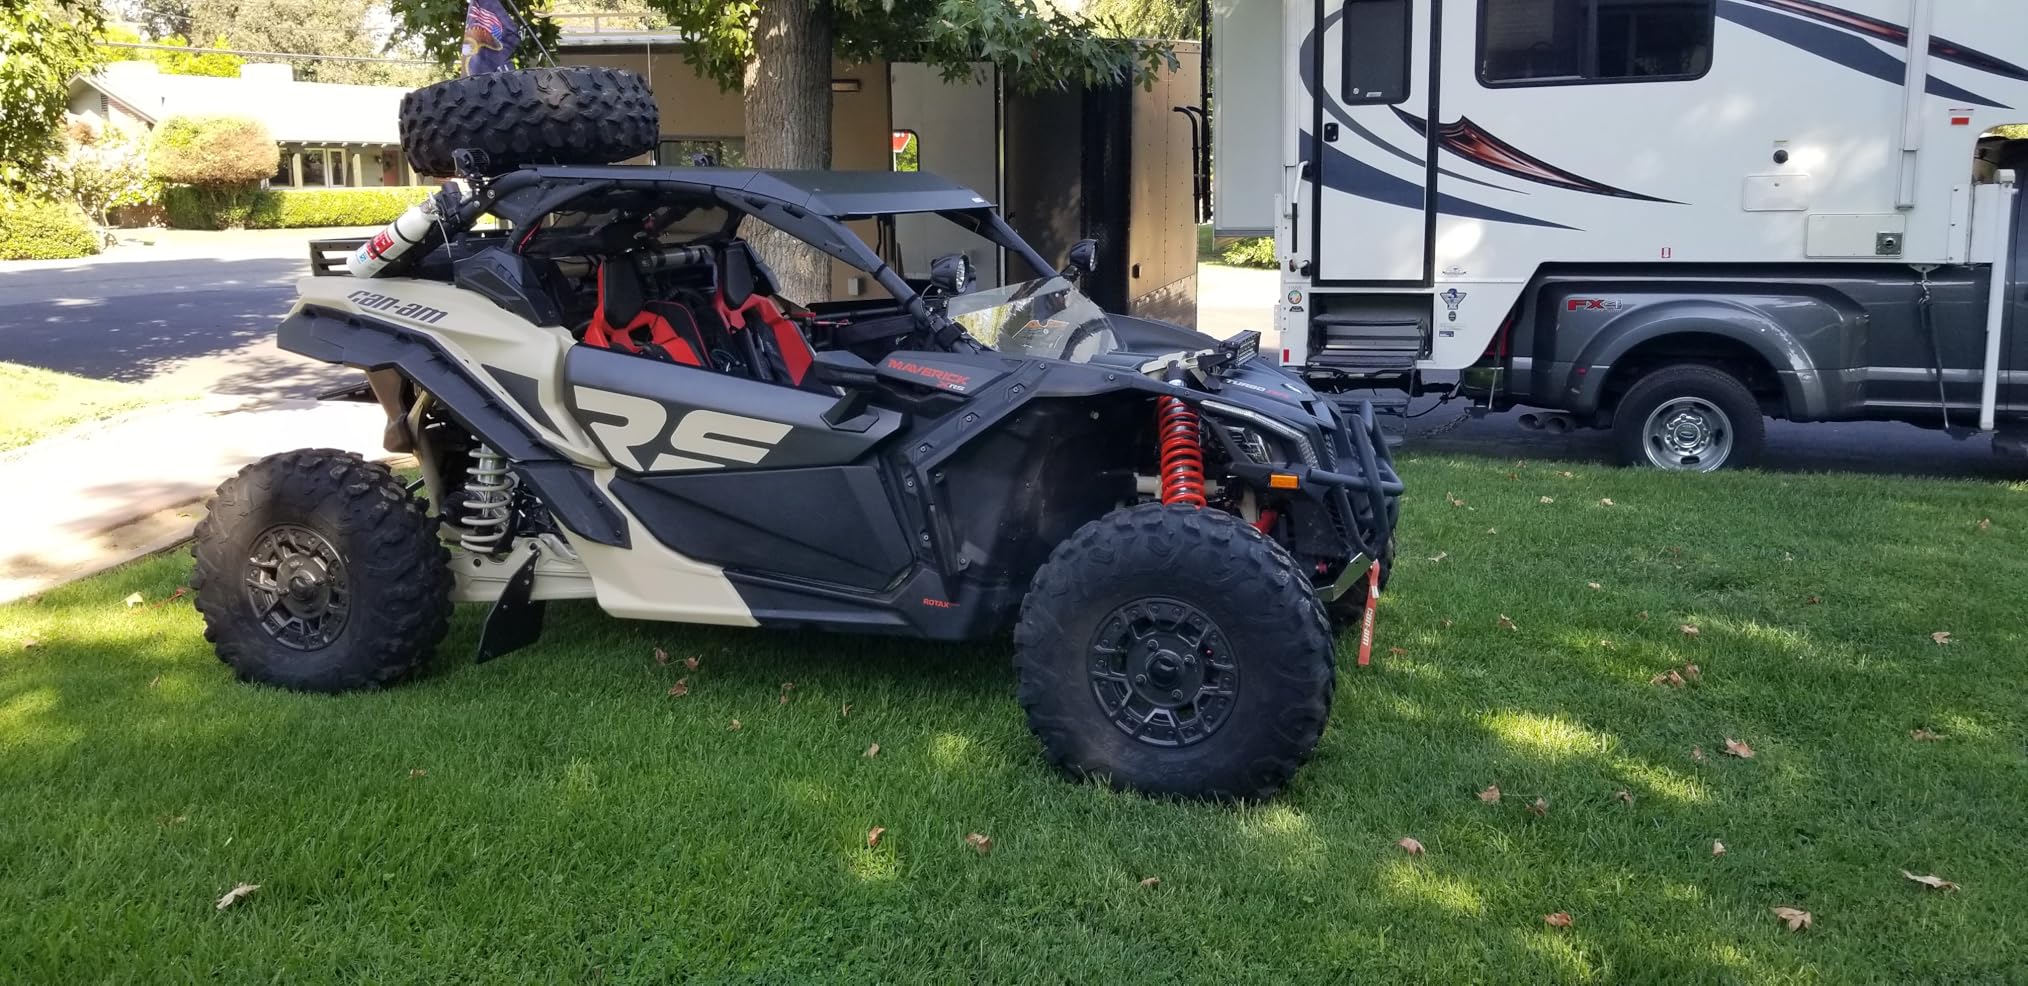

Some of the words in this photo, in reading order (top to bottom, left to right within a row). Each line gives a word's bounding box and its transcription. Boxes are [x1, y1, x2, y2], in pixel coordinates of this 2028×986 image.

[347, 290, 448, 324] can-am
[1567, 298, 1622, 312] FX4
[887, 358, 970, 385] MAVERICK
[1225, 378, 1266, 392] TURBO
[573, 385, 794, 472] RS
[922, 598, 950, 608] ROTAX
[1362, 607, 1374, 647] can-am
